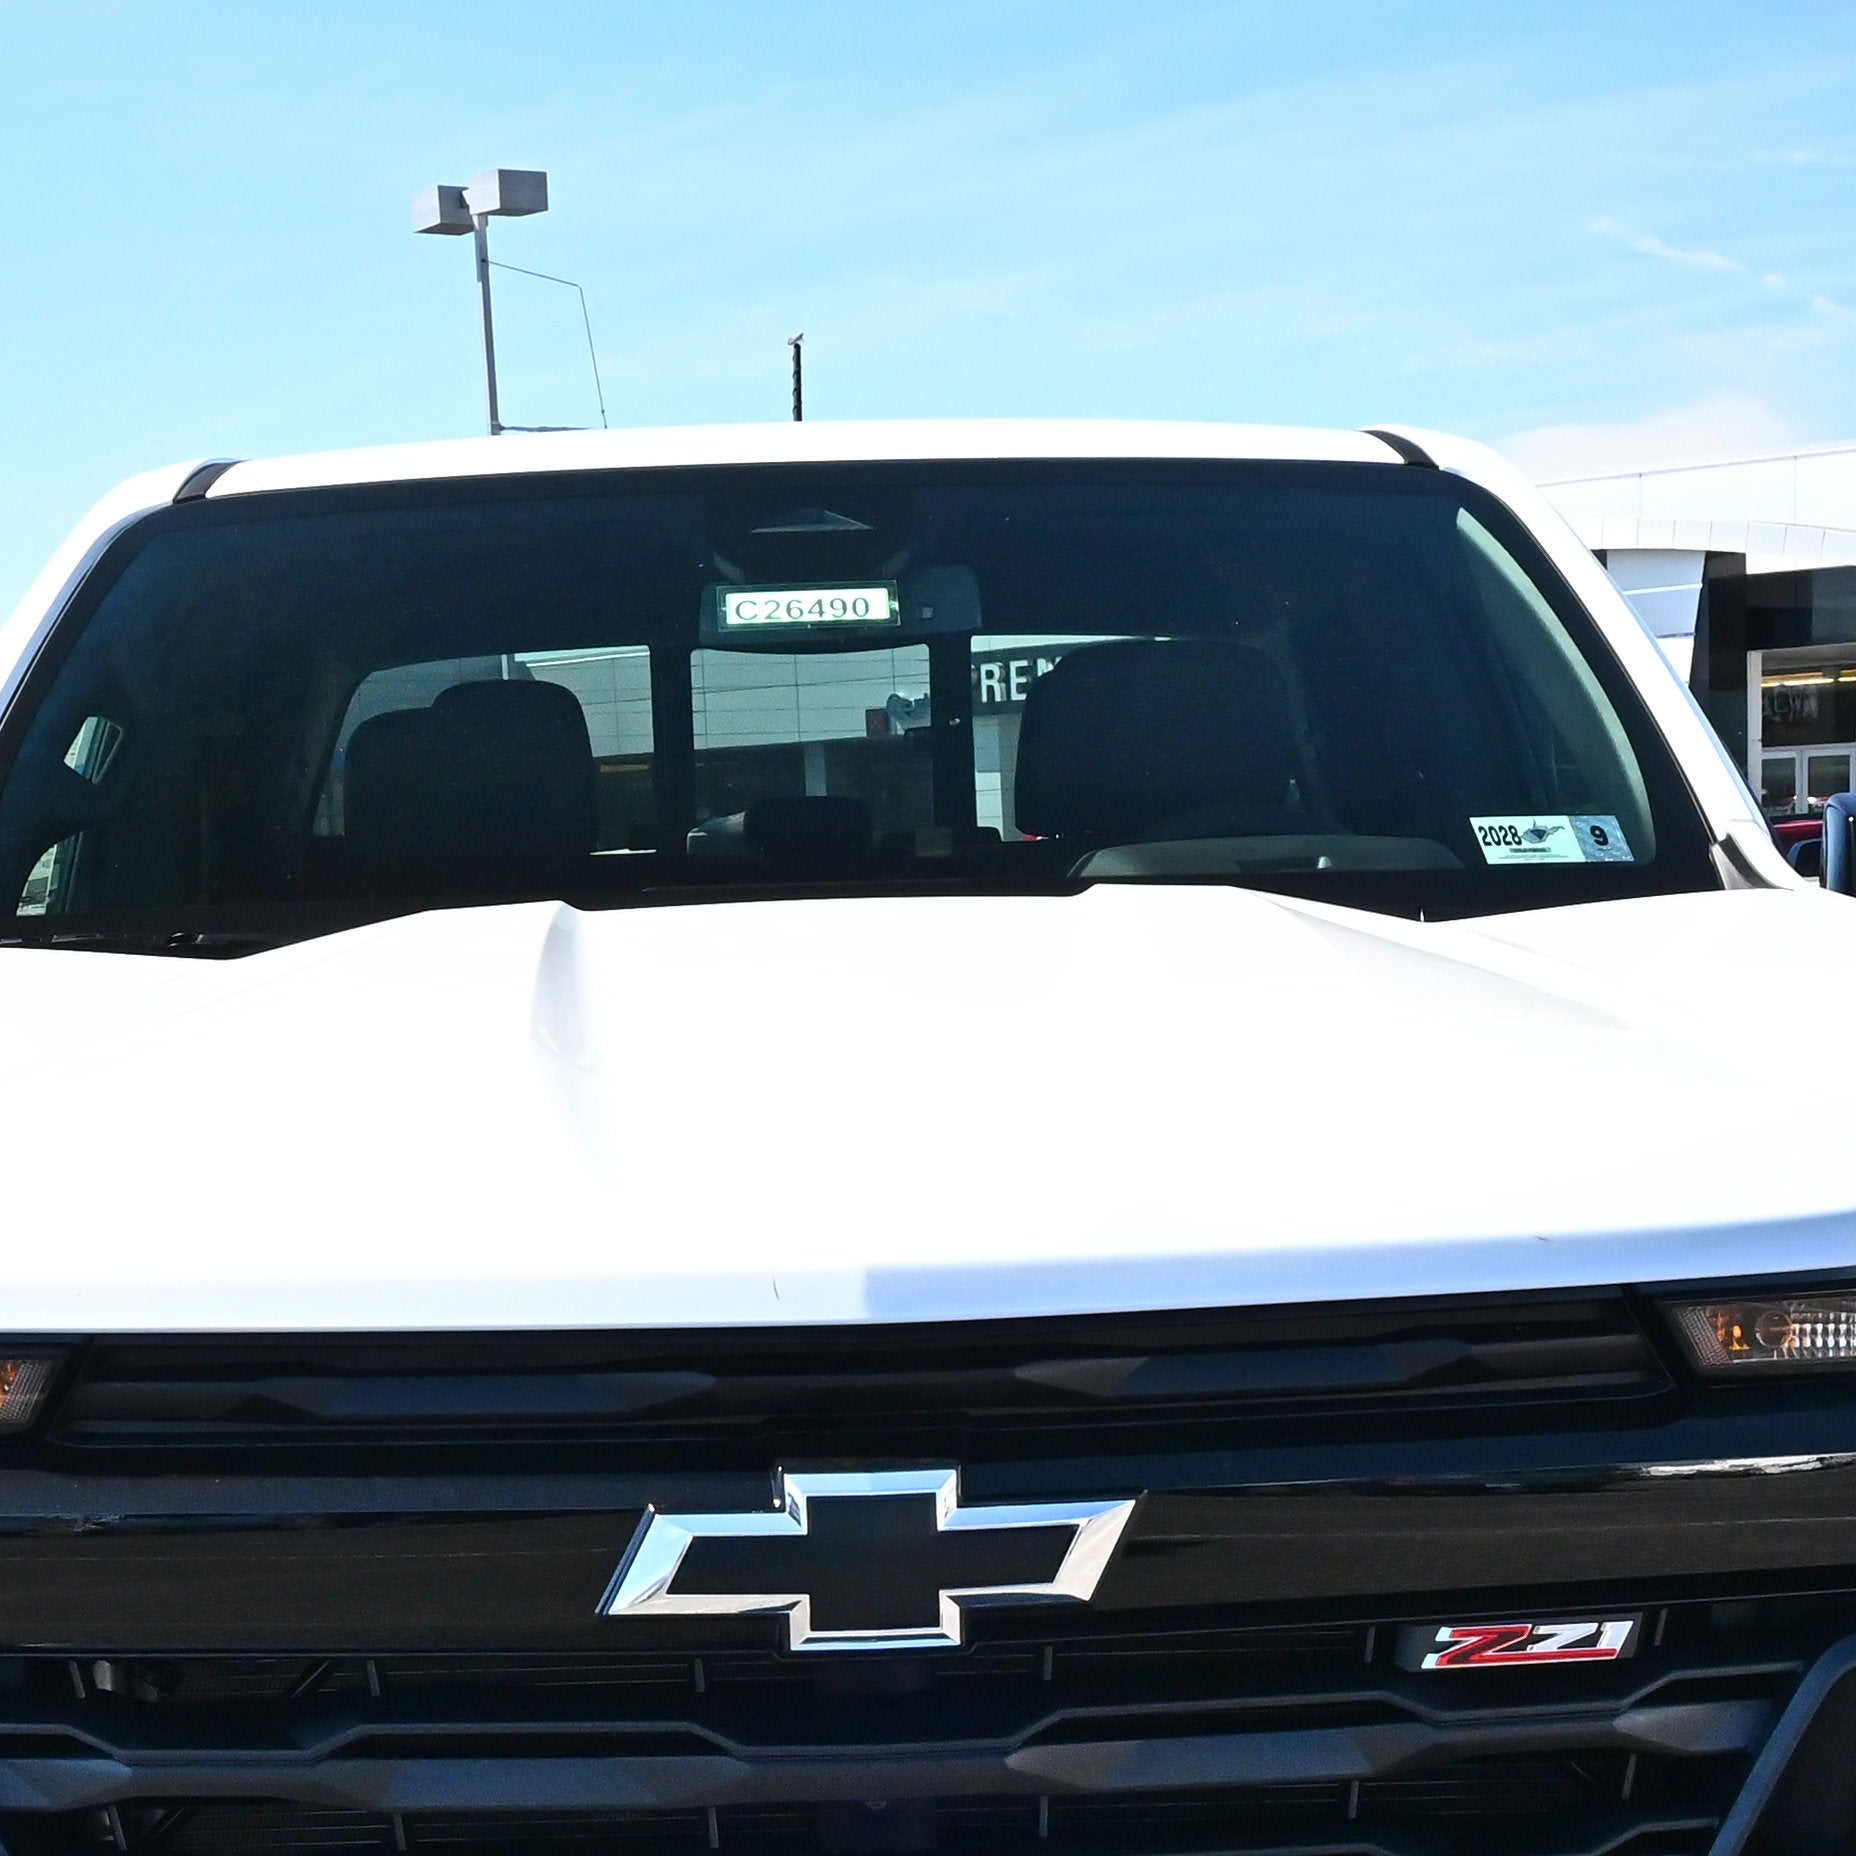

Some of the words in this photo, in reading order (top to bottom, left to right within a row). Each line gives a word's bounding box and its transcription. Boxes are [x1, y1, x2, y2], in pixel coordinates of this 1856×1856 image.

[734, 597, 870, 621] C26490
[1477, 824, 1523, 847] 2028
[1589, 825, 1610, 847] 9
[1421, 1620, 1634, 1670] Z71
